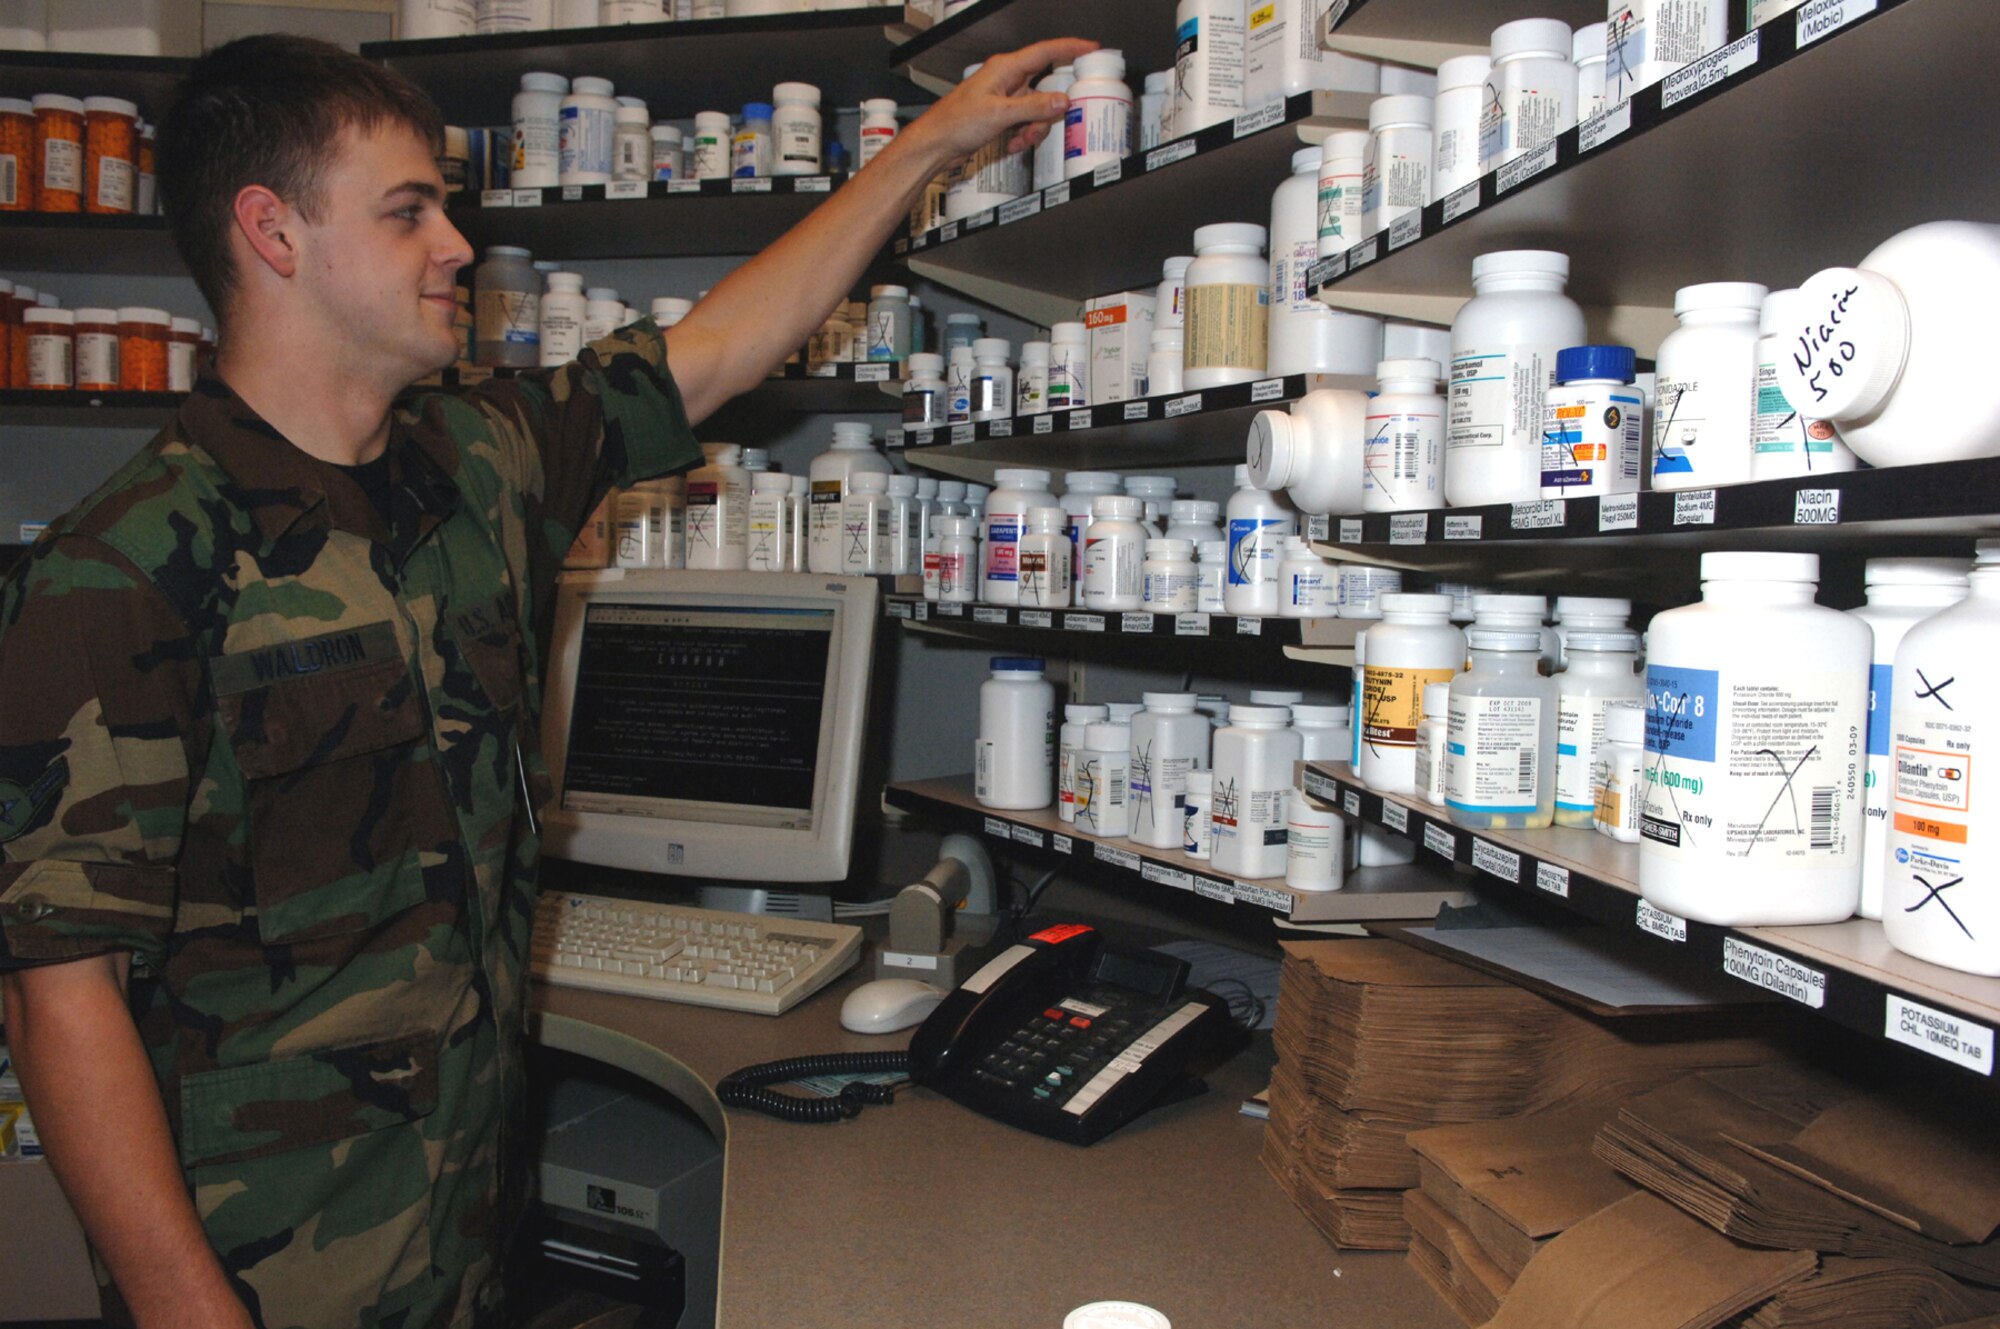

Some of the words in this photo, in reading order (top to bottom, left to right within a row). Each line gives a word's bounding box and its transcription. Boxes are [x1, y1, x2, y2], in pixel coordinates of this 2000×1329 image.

[1803, 7, 1843, 41] (Mobic)
[1662, 32, 1758, 91] Medroxyprogesterone
[1498, 160, 1523, 180] Losartan
[1523, 139, 1556, 164] Potassium
[1292, 290, 1306, 301] 18
[1793, 284, 1858, 376] Niacin
[1810, 341, 1856, 402] 500
[1544, 500, 1554, 512] ER
[1797, 490, 1832, 505] Niacin
[1601, 502, 1637, 513] Metronidazole
[1676, 502, 1698, 513] Sodium
[1699, 500, 1714, 511] 4MG
[1796, 506, 1837, 523] 500MG
[1616, 511, 1636, 521] 250MG
[1675, 512, 1704, 523] (Singular)
[251, 631, 367, 682] WALDRON
[1694, 695, 1704, 717] 8
[1849, 725, 1858, 756] 03-09
[1905, 735, 1926, 745] Capsules
[1946, 739, 1955, 748] Rx
[1956, 741, 1971, 751] only
[1898, 760, 1928, 777] Dilantin
[1682, 775, 1704, 796] mg)
[1846, 763, 1857, 800] 240550
[1919, 778, 1949, 791] Phenytoin
[1683, 811, 1693, 823] Rx
[1694, 813, 1713, 828] only
[1867, 807, 1887, 820] only
[1913, 819, 1926, 832] 100
[1927, 823, 1940, 837] mg
[1910, 855, 1950, 870] Parke-Davis
[1234, 882, 1259, 896] Losartan
[1637, 905, 1673, 925] POTASSIUM
[1670, 928, 1686, 940] TAB
[906, 956, 913, 966] 2
[1724, 938, 1773, 969] Phenytoin
[1775, 958, 1826, 989] Capsules
[1724, 956, 1760, 982] 100MG
[1761, 970, 1809, 1004] (Dilantin)
[1900, 1006, 1960, 1037] POTASSIUM
[1925, 1028, 1960, 1052] 10MEQ
[1960, 1041, 1983, 1060] TAB
